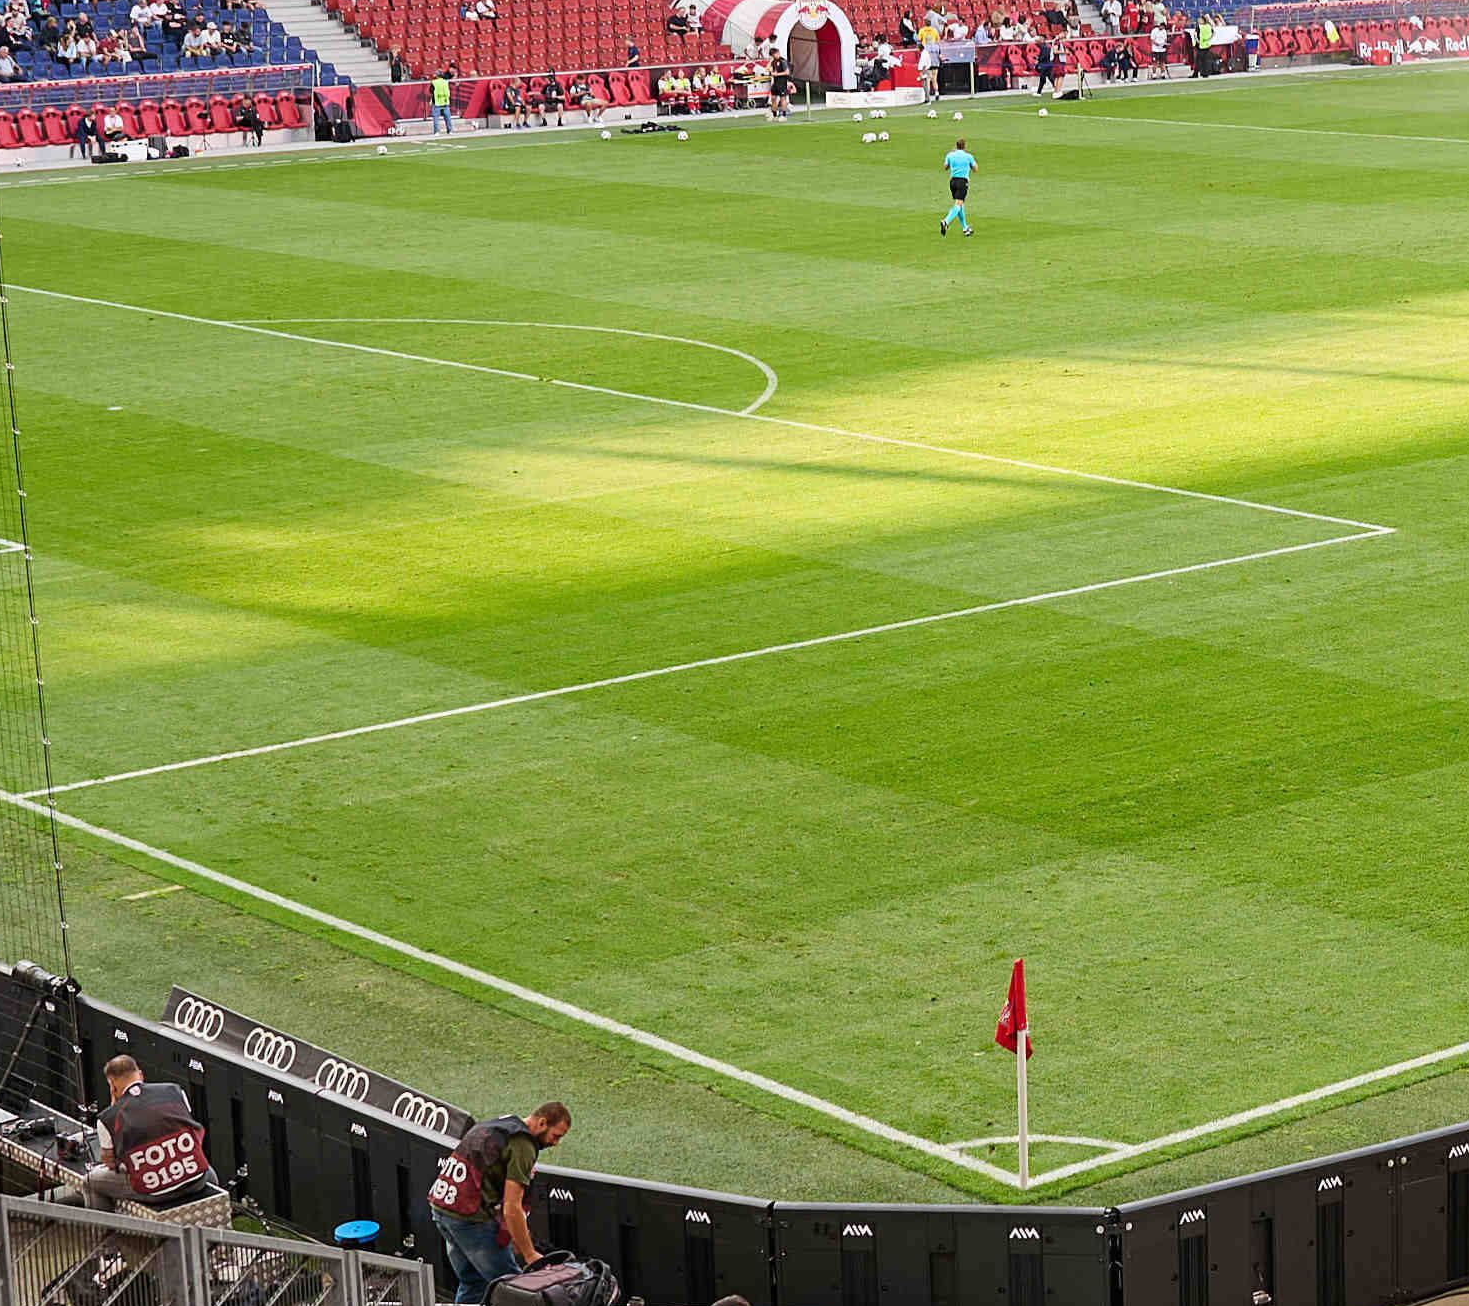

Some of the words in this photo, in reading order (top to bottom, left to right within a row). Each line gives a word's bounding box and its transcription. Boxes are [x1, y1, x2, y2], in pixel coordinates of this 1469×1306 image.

[1444, 35, 1467, 53] Red
[131, 1132, 195, 1172] FOTO
[143, 1157, 199, 1190] 9195
